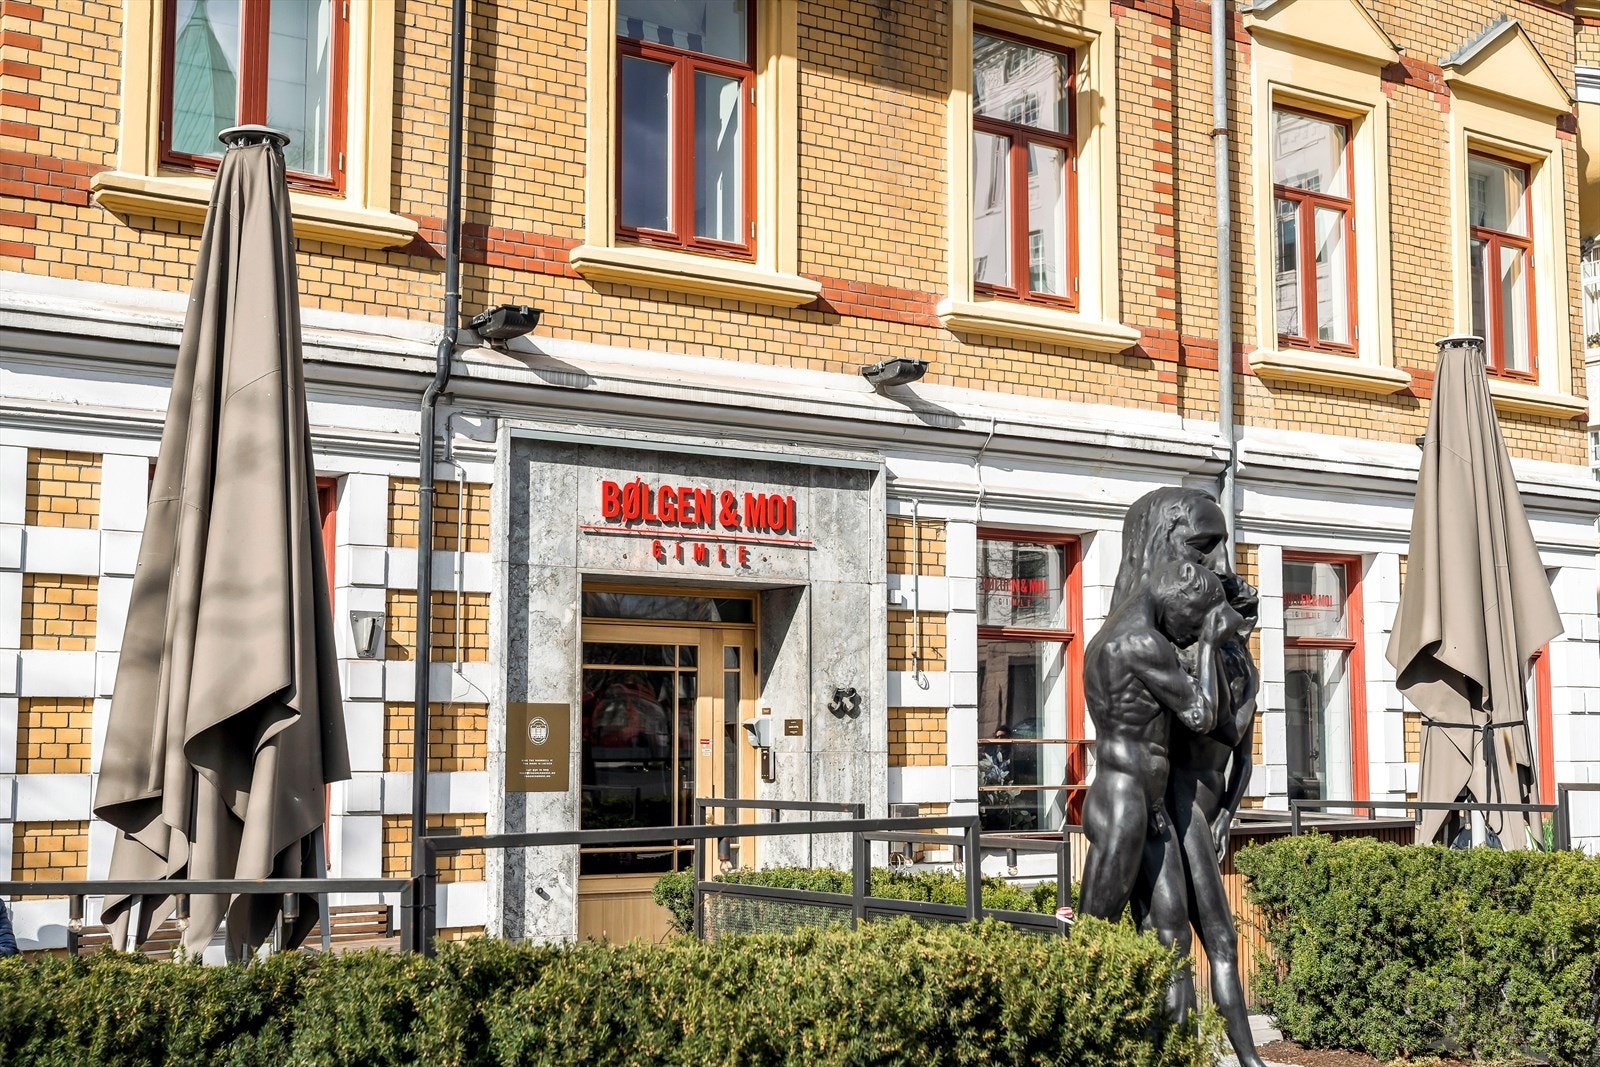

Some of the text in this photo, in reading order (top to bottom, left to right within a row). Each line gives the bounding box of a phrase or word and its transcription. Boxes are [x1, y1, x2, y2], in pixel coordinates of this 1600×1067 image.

[602, 478, 794, 531] BØLGEN & MOI
[652, 539, 748, 563] GIMLE
